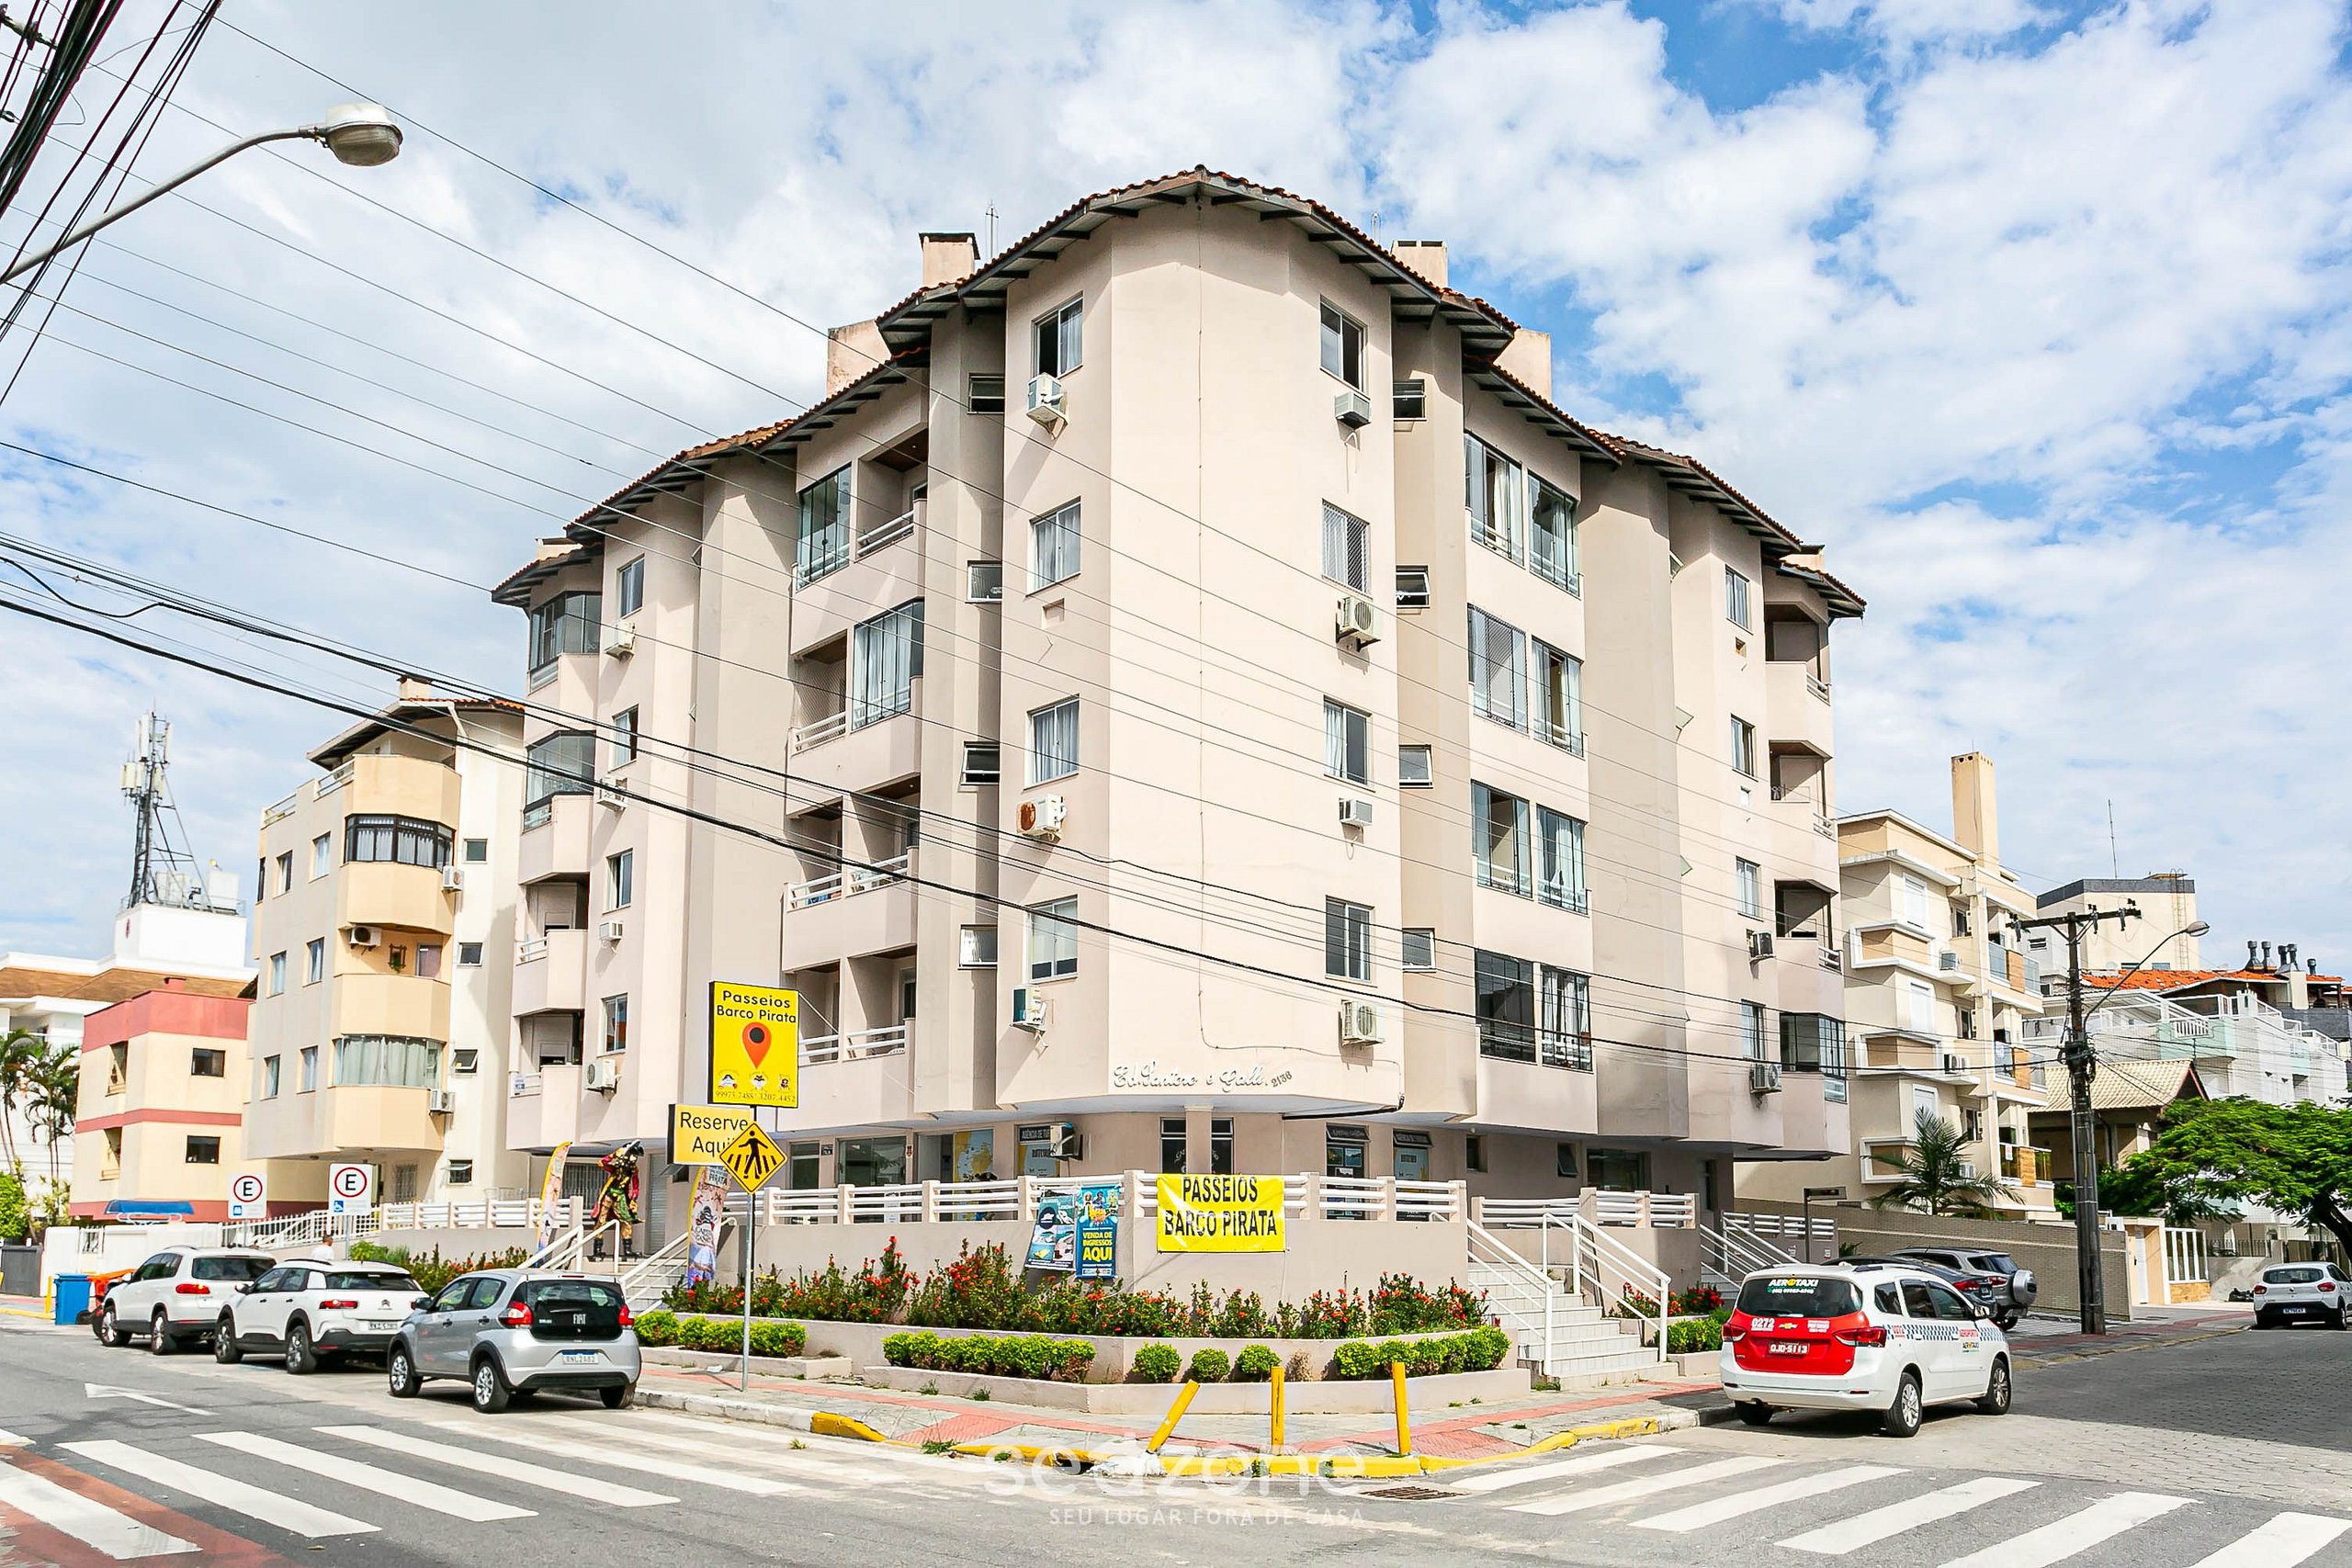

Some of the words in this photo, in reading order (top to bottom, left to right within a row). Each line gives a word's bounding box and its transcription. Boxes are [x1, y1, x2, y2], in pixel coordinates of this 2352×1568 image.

[722, 990, 791, 1009] Passeios
[717, 1004, 753, 1019] Barco
[759, 1009, 797, 1023] Pirata
[680, 1111, 749, 1131] Reserve
[243, 1180, 254, 1197] E
[345, 1173, 357, 1191] E
[1182, 1176, 1259, 1202] PASSEIOS
[1164, 1209, 1217, 1237] BARCO
[1222, 1209, 1278, 1236] PIRATA
[1104, 1231, 1113, 1239] DE
[1082, 1247, 1113, 1263] AQUI
[572, 1314, 586, 1325] FIAT
[1751, 1317, 1775, 1328] 0272
